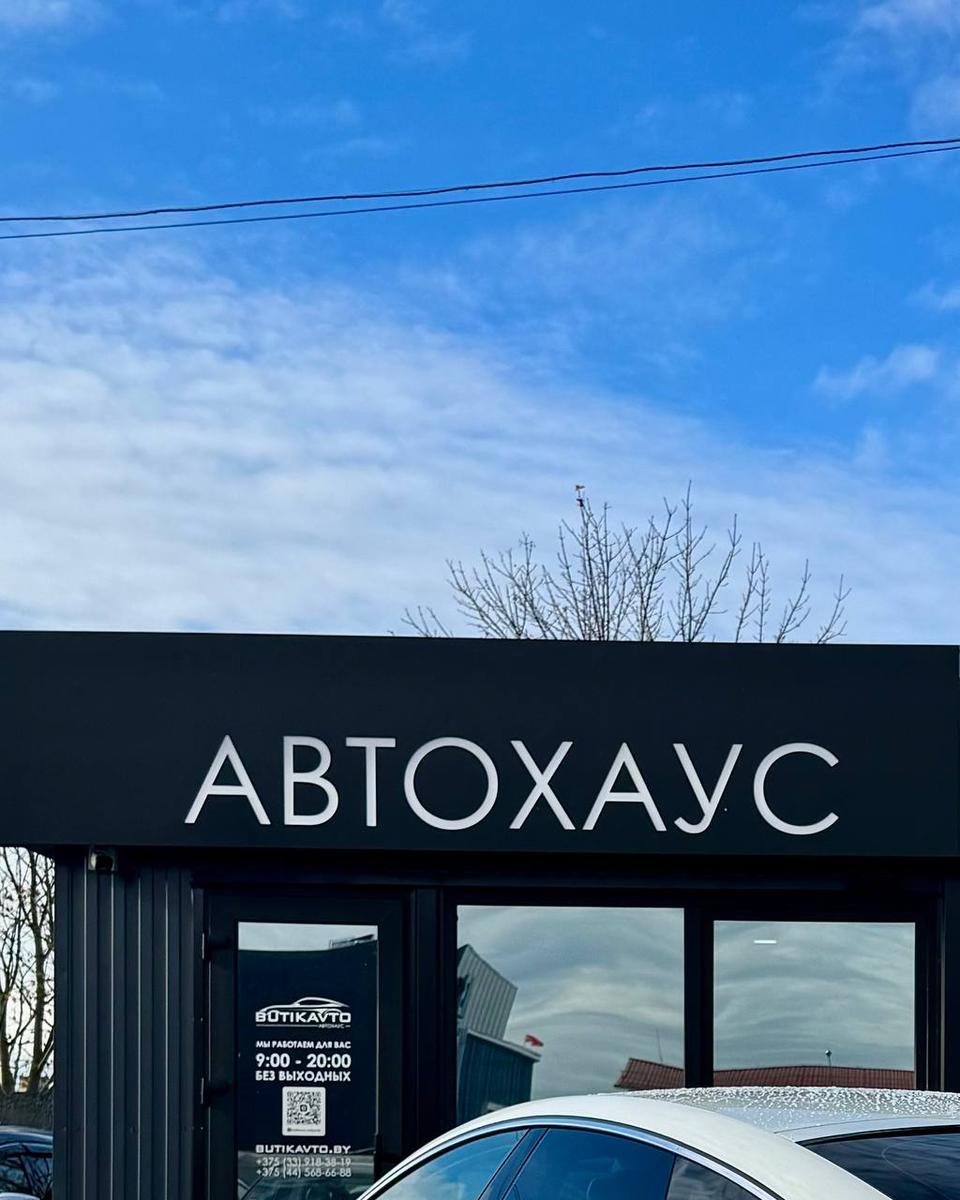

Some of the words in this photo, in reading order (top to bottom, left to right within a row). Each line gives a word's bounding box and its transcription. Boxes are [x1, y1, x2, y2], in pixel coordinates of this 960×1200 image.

[185, 734, 839, 836] АВТОХАУС
[255, 1011, 352, 1023] BUTIKAVTO
[256, 1041, 271, 1049] МЫ
[272, 1041, 314, 1049] РАБОТАЕМ
[315, 1041, 333, 1050] ДЛЯ
[334, 1041, 352, 1049] ВАС
[255, 1053, 290, 1068] 9:00
[306, 1053, 352, 1069] 20:00
[255, 1070, 276, 1081] БЕЗ
[278, 1070, 352, 1082] ВЫХОДНЫХ
[255, 1144, 351, 1154] BUTIKAVTO.BY
[256, 1157, 280, 1167] +375
[283, 1156, 302, 1169] (33)
[304, 1157, 352, 1167] 918-38-19
[256, 1168, 280, 1178] +375
[283, 1167, 302, 1179] (44)
[304, 1168, 352, 1178] 568-66-88
